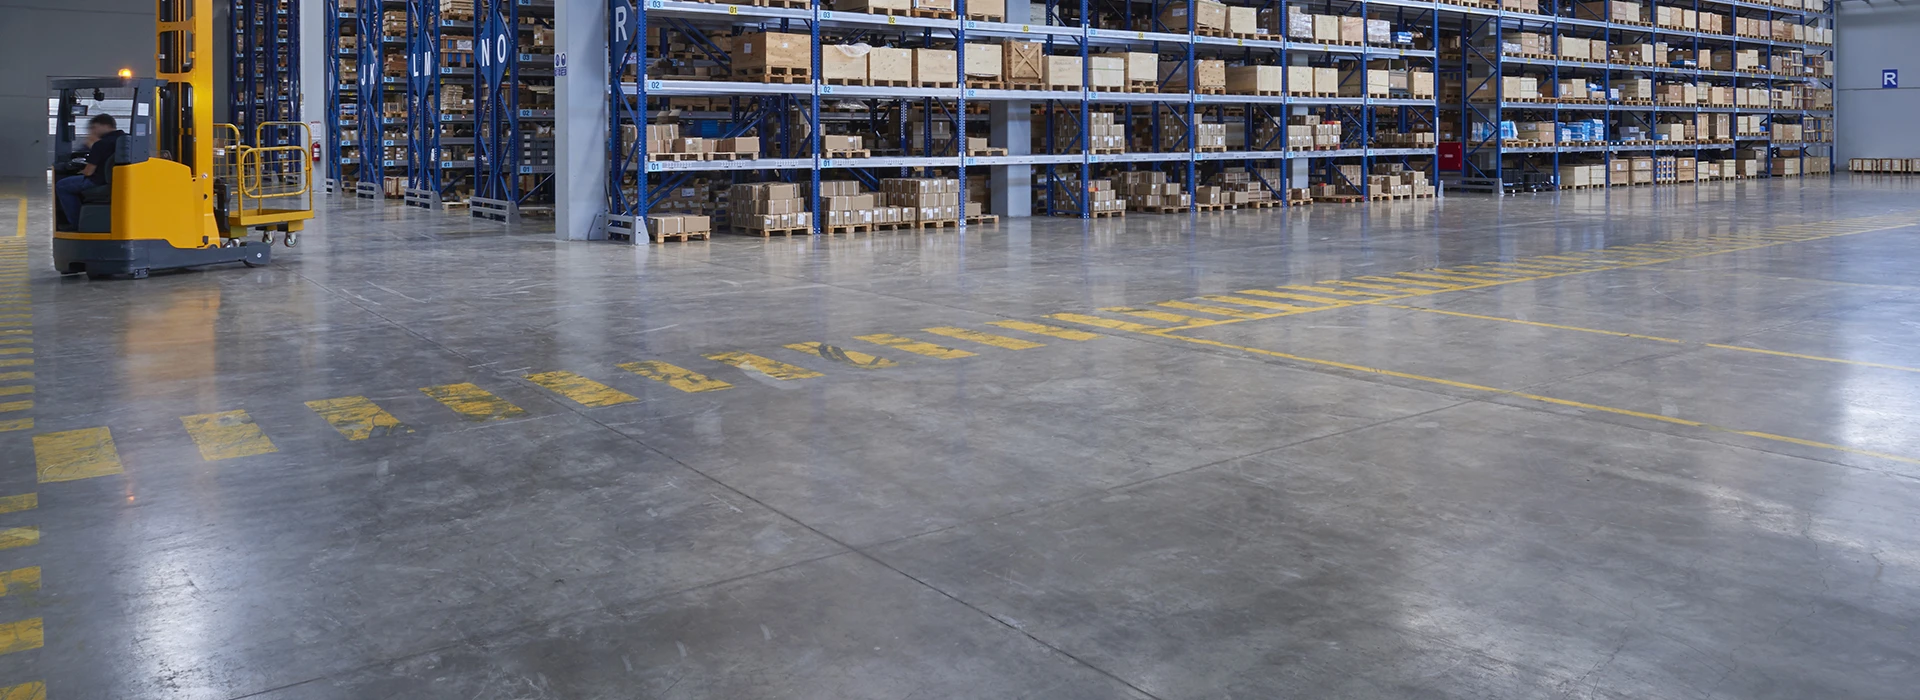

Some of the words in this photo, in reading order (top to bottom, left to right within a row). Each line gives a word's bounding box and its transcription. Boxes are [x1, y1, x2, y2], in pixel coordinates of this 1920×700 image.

[616, 6, 628, 42] R
[482, 38, 489, 66] N
[497, 34, 506, 63] O
[361, 65, 365, 85] J
[370, 64, 375, 84] K
[413, 54, 419, 76] L
[424, 51, 430, 76] M
[1884, 72, 1896, 85] R
